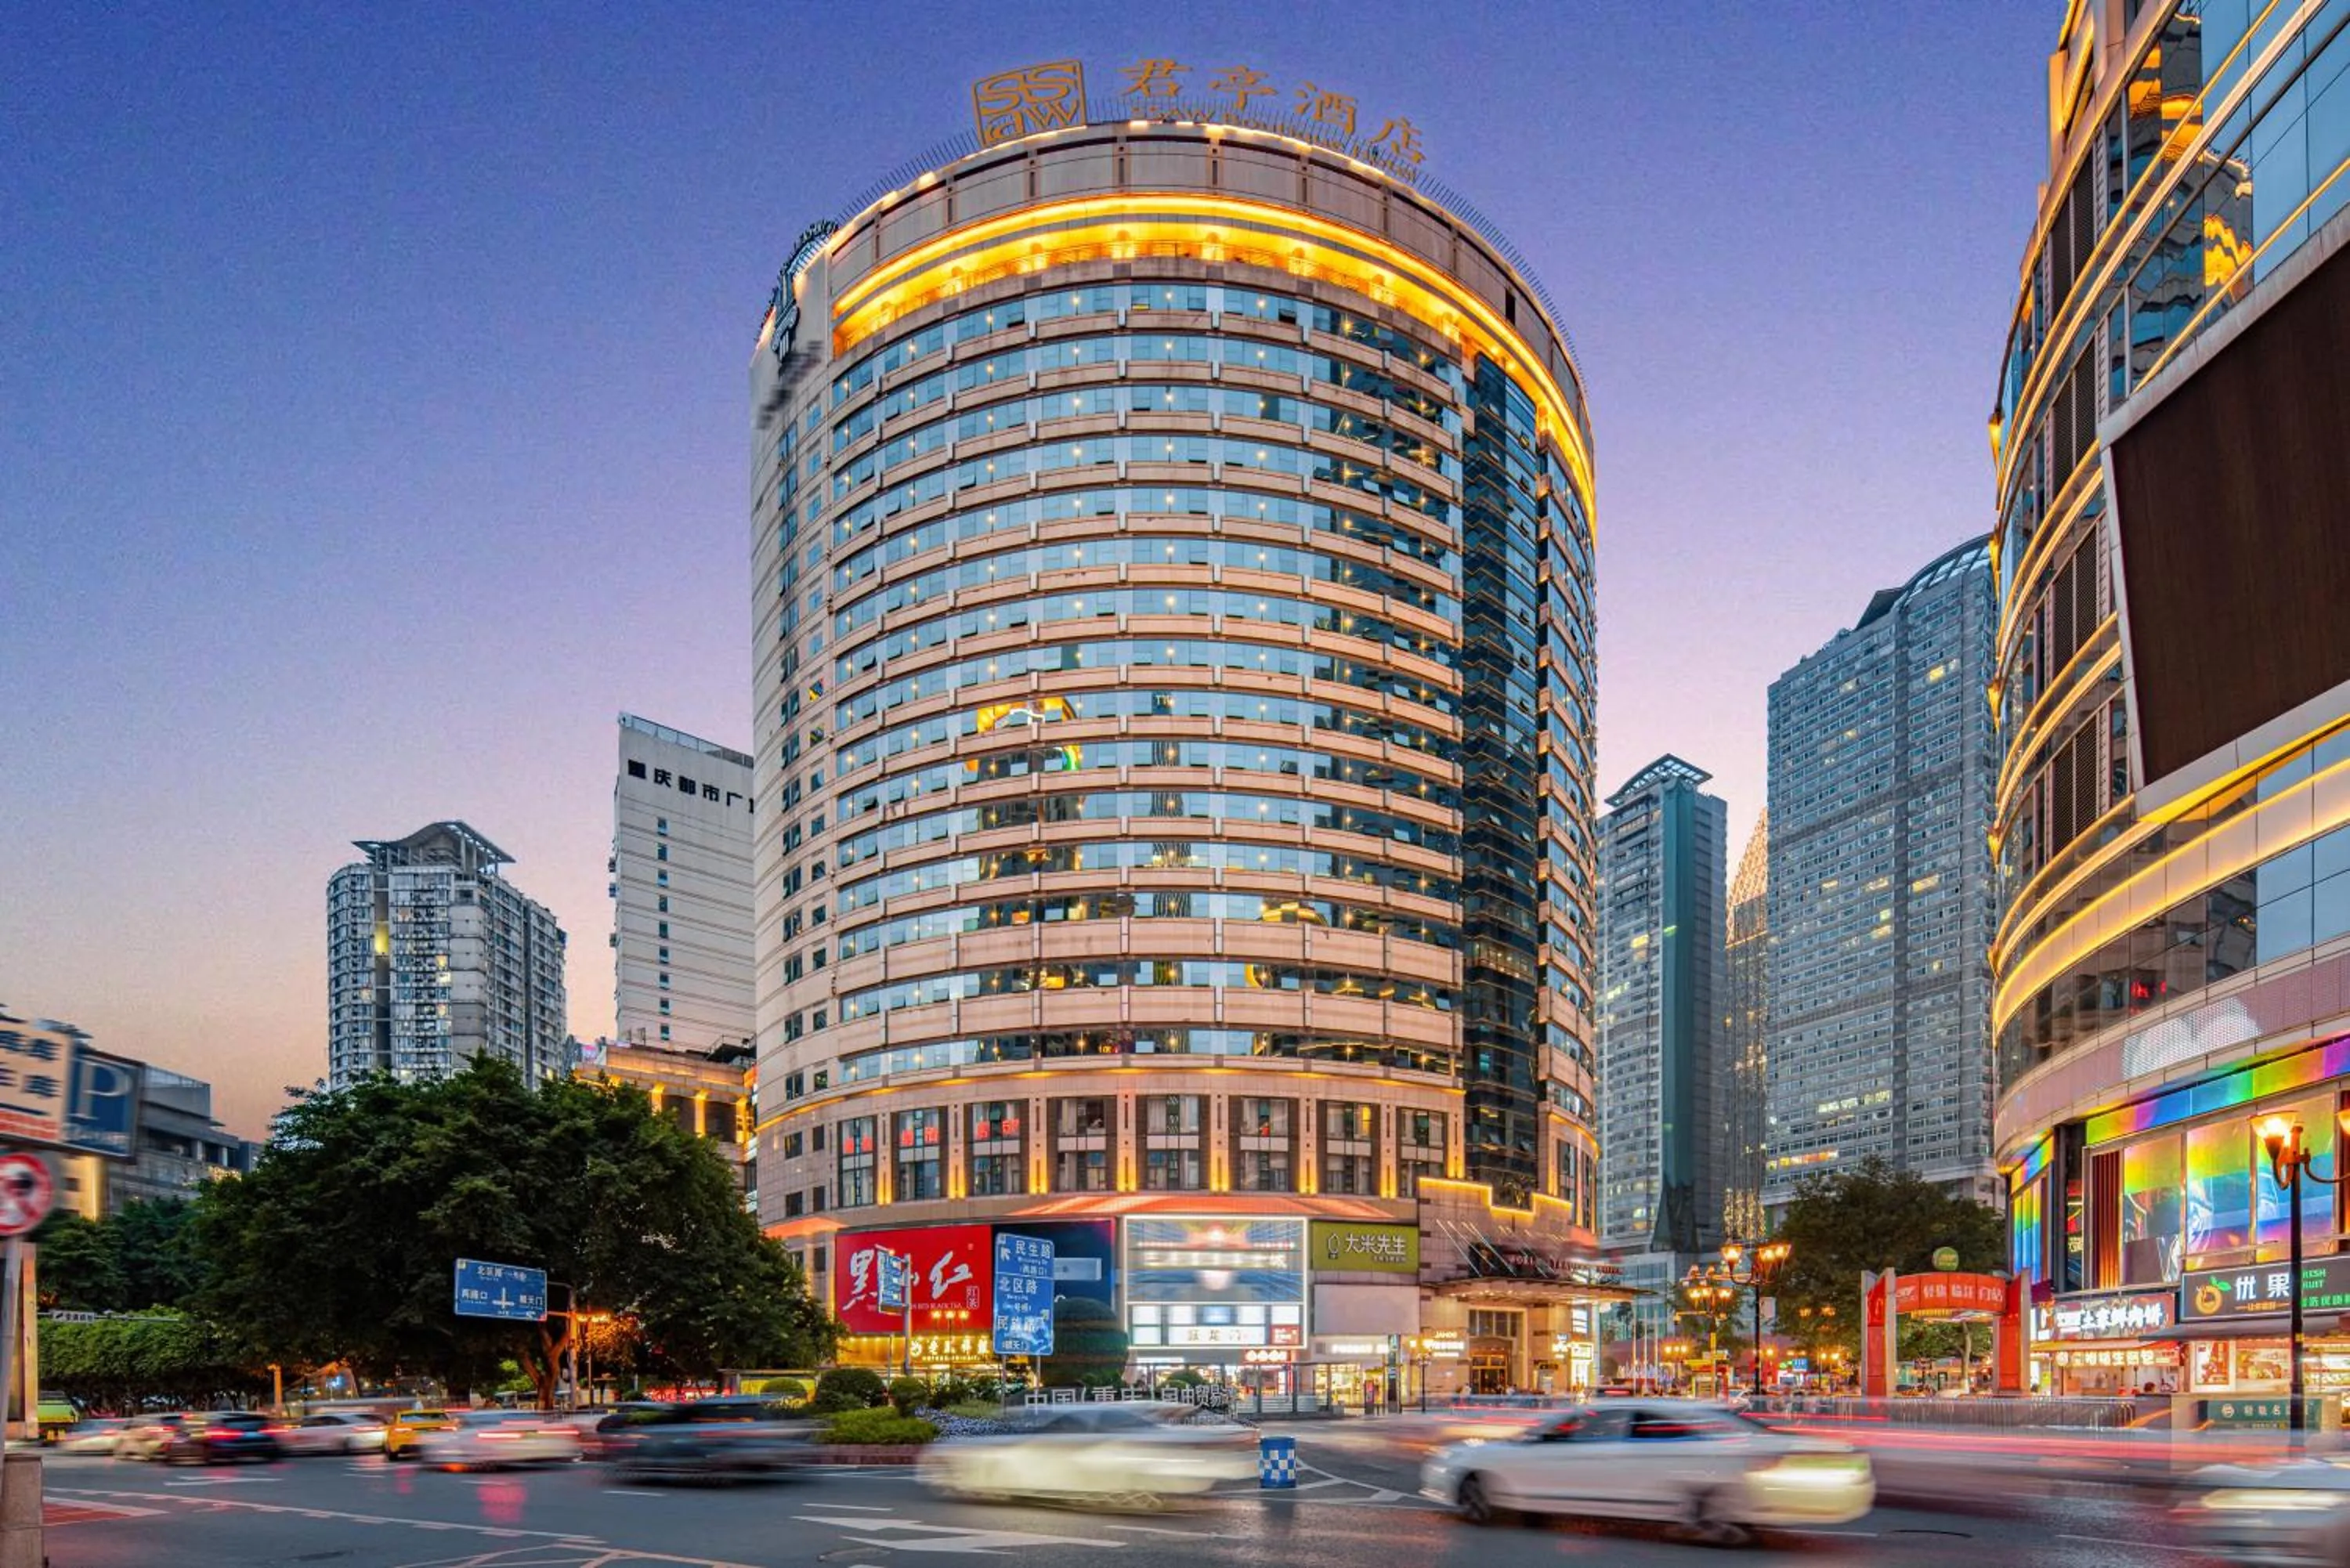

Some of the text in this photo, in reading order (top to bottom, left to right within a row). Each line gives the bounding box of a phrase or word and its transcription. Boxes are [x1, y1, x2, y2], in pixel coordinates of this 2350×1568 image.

[1116, 58, 1427, 164] 君亭酒店
[627, 758, 754, 815] 庆都市广
[1015, 1240, 1050, 1259] 民生路
[1345, 1234, 1406, 1255] 大米先生
[999, 1276, 1038, 1294] 北区路
[2236, 1273, 2290, 1301] 优果
